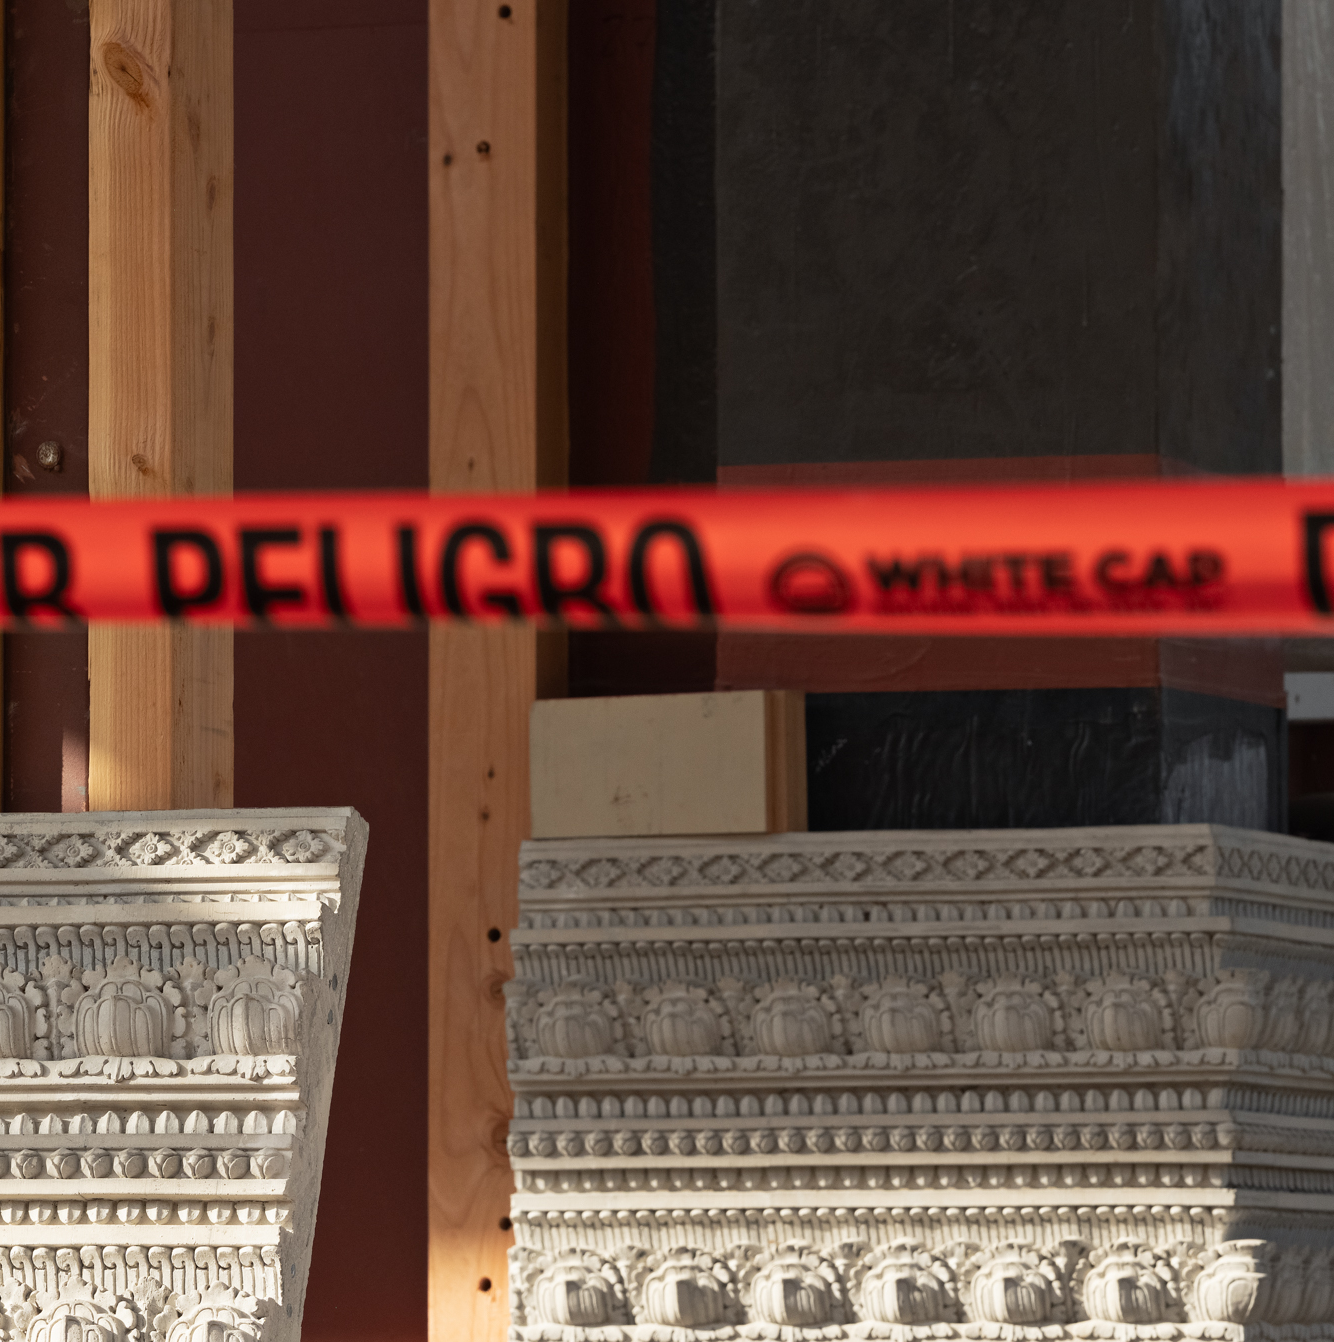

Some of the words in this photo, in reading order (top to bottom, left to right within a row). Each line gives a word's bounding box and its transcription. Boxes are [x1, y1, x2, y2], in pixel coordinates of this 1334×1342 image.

[148, 520, 723, 628] PELIGRO
[866, 548, 1074, 592] WHITE
[1093, 548, 1227, 592] CAP
